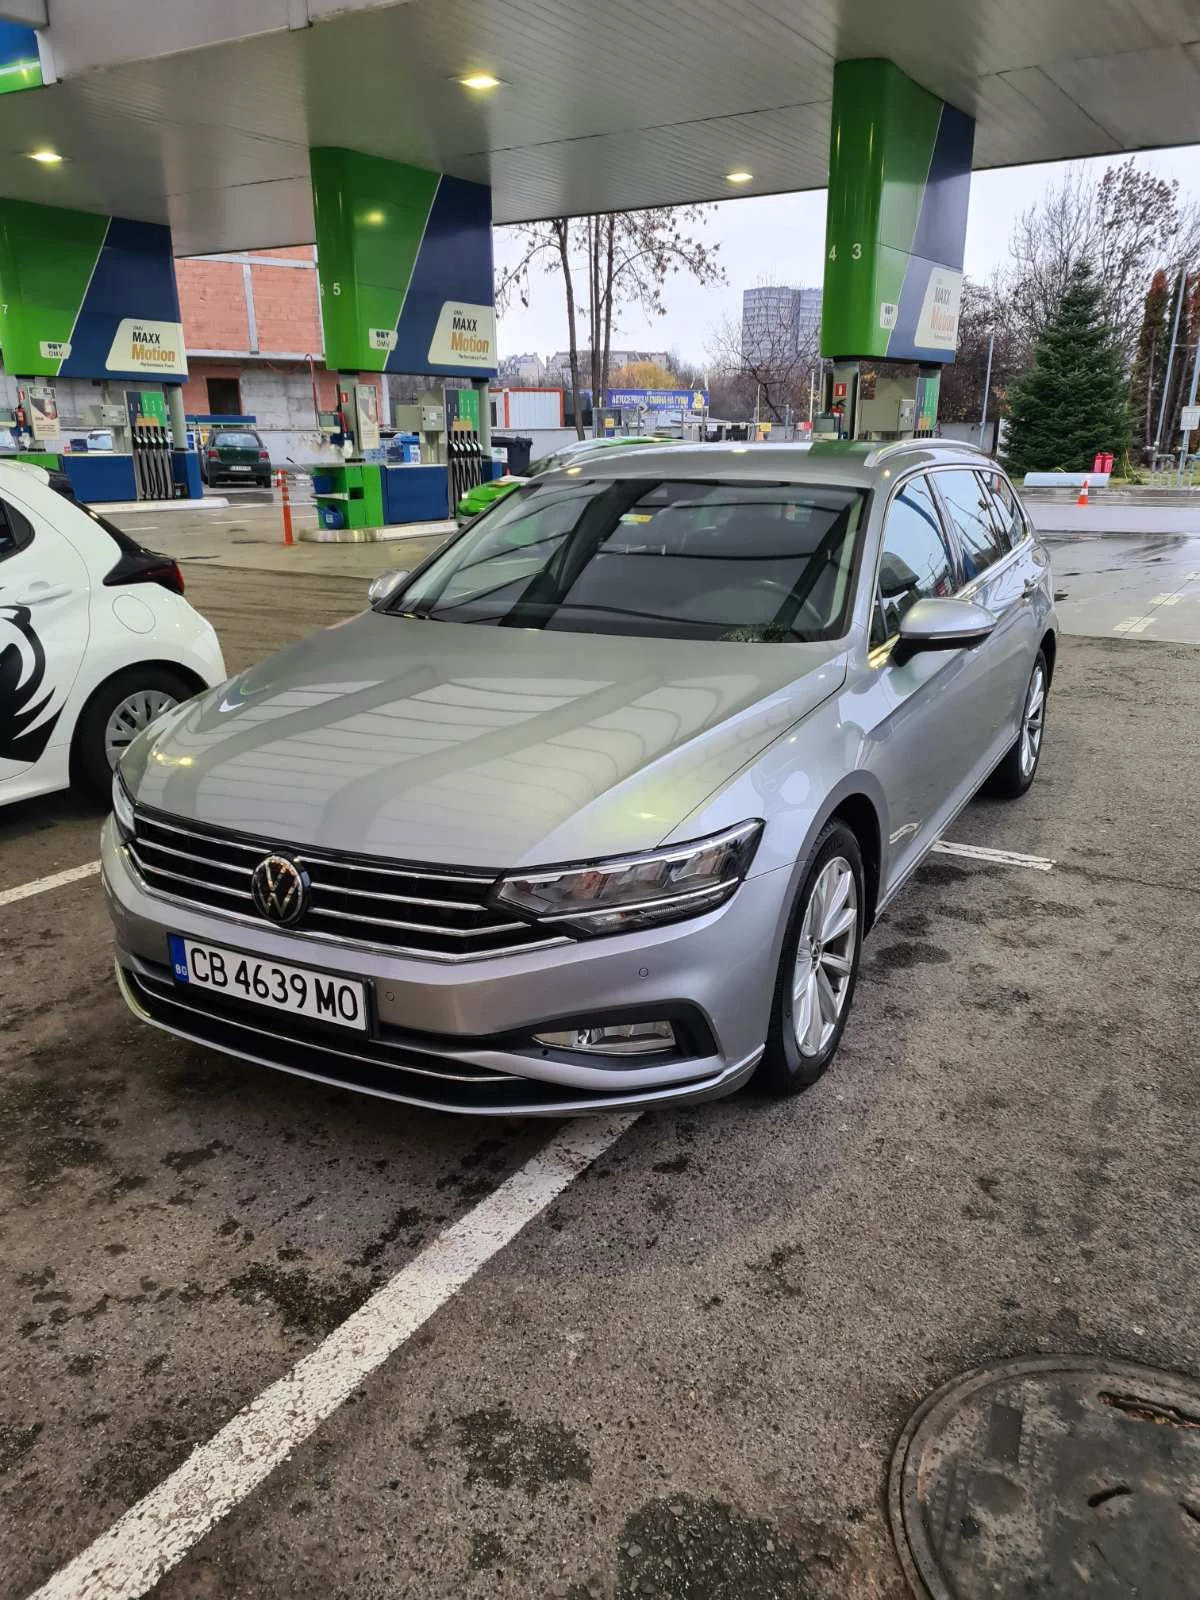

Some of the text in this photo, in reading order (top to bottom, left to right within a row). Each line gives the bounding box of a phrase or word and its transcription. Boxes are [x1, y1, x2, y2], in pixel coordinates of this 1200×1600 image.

[828, 243, 862, 261] 4 3
[333, 282, 341, 296] 5
[1, 304, 9, 314] 7
[452, 317, 478, 332] MAXX
[132, 332, 161, 344] MAXX
[450, 332, 489, 354] Motion
[131, 344, 176, 362] Motion
[175, 963, 188, 976] BG
[190, 947, 359, 1021] CB 4639 MO
